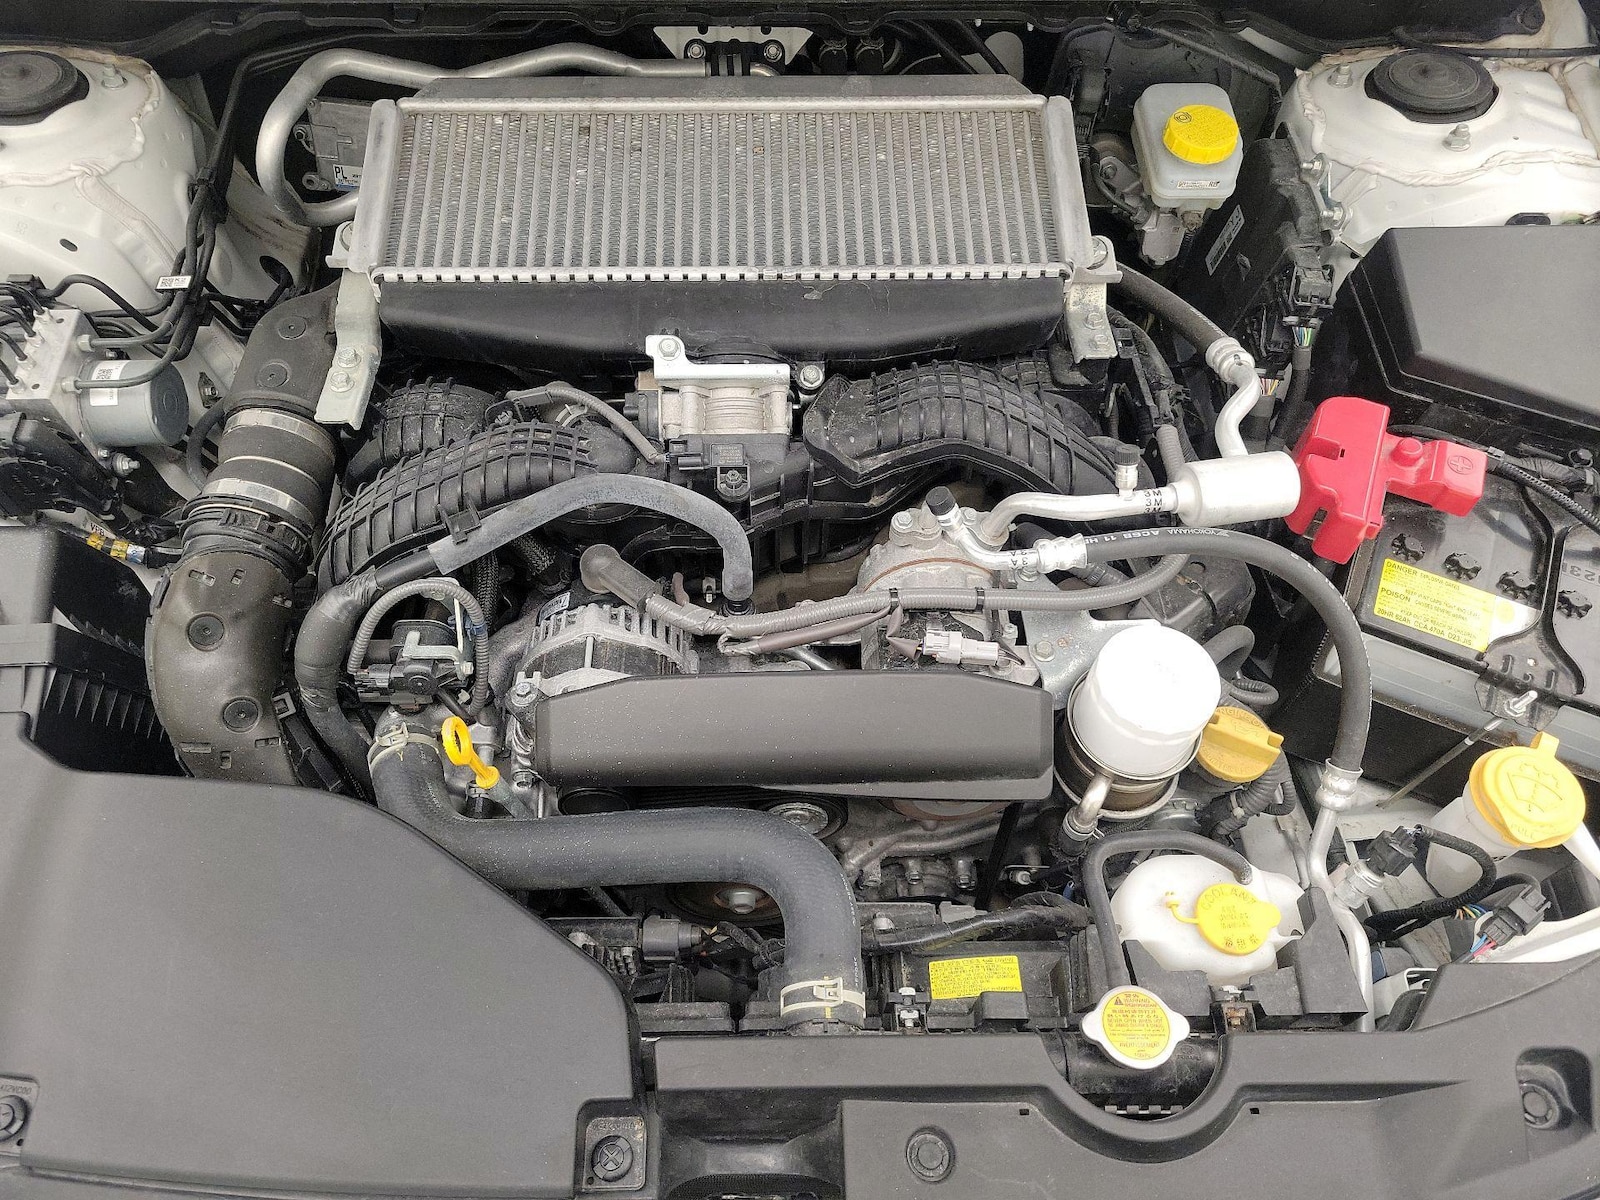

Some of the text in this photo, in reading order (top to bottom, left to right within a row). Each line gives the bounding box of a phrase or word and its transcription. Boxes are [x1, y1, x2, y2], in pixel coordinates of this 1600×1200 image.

[335, 166, 348, 179] PL
[1386, 561, 1418, 576] DANGER
[1380, 587, 1411, 603] POISON
